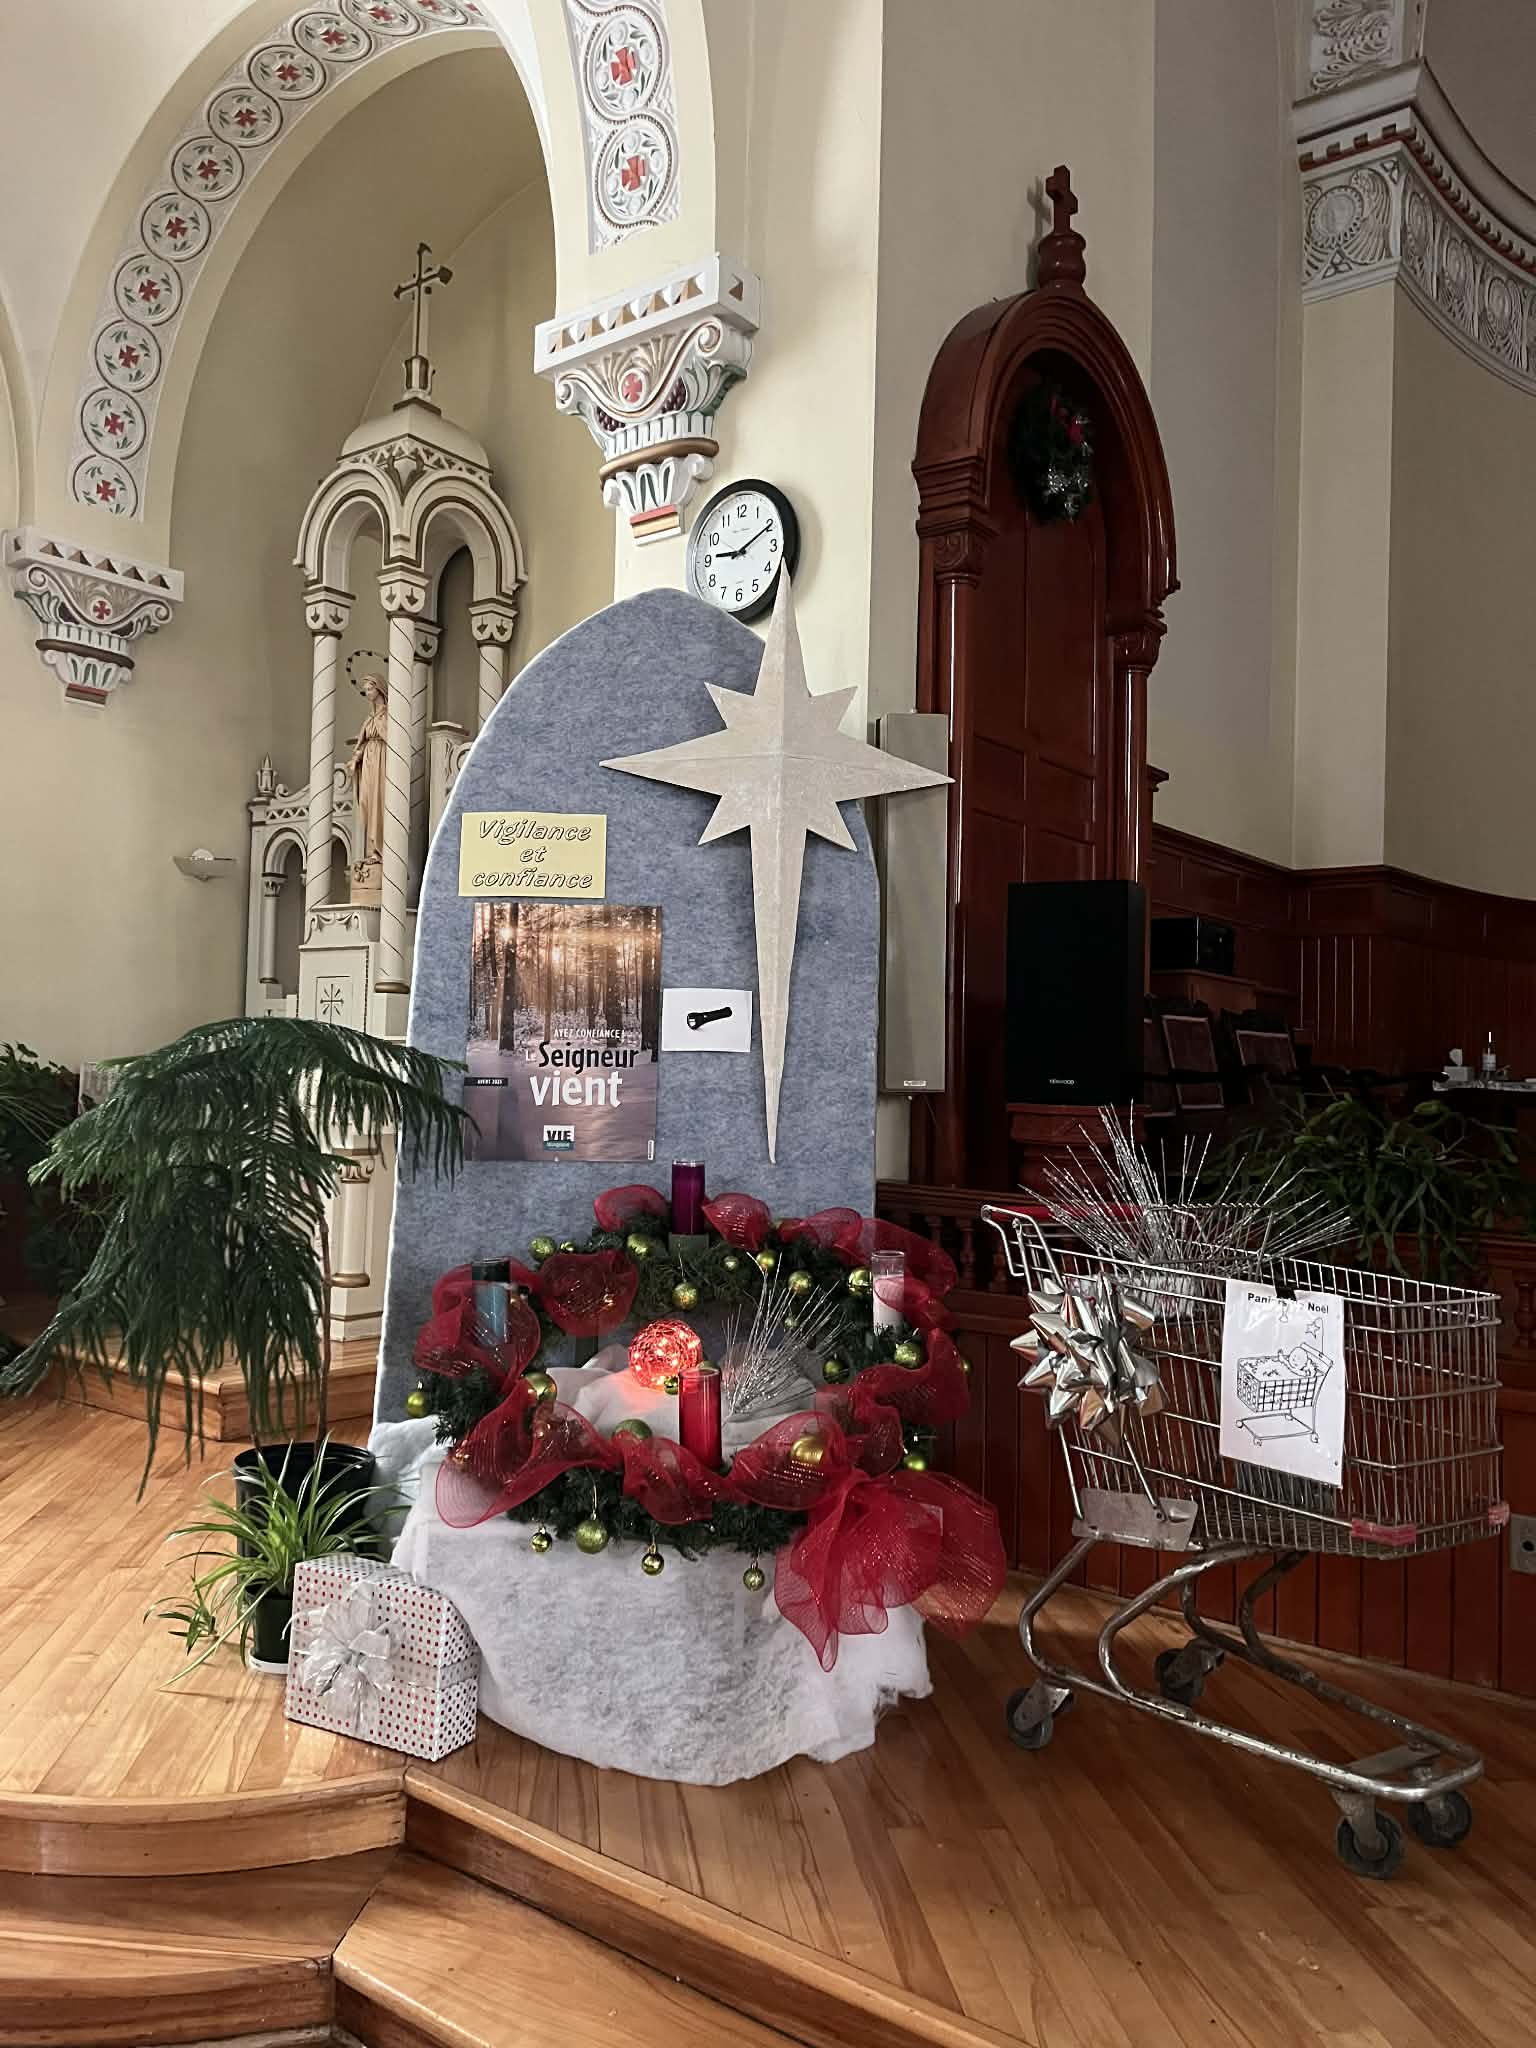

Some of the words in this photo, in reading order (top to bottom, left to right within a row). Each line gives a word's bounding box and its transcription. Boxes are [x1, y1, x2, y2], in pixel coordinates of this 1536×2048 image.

[737, 504, 747, 518] 12
[722, 514, 730, 528] 11
[765, 519, 773, 532] 2
[709, 532, 720, 547] 10
[769, 539, 778, 553] 3
[704, 554, 712, 568] 9
[764, 561, 772, 574] 4
[708, 574, 716, 588] 8
[752, 578, 759, 593] 5
[720, 586, 727, 600] 7
[735, 588, 743, 602] 6
[479, 819, 592, 845] Vigilance
[519, 845, 547, 863] et
[471, 867, 593, 889] confiance
[553, 1028, 574, 1038] AYEZ
[538, 1040, 640, 1075] Seigneur
[529, 1069, 623, 1108] vient
[546, 1130, 571, 1142] VIE
